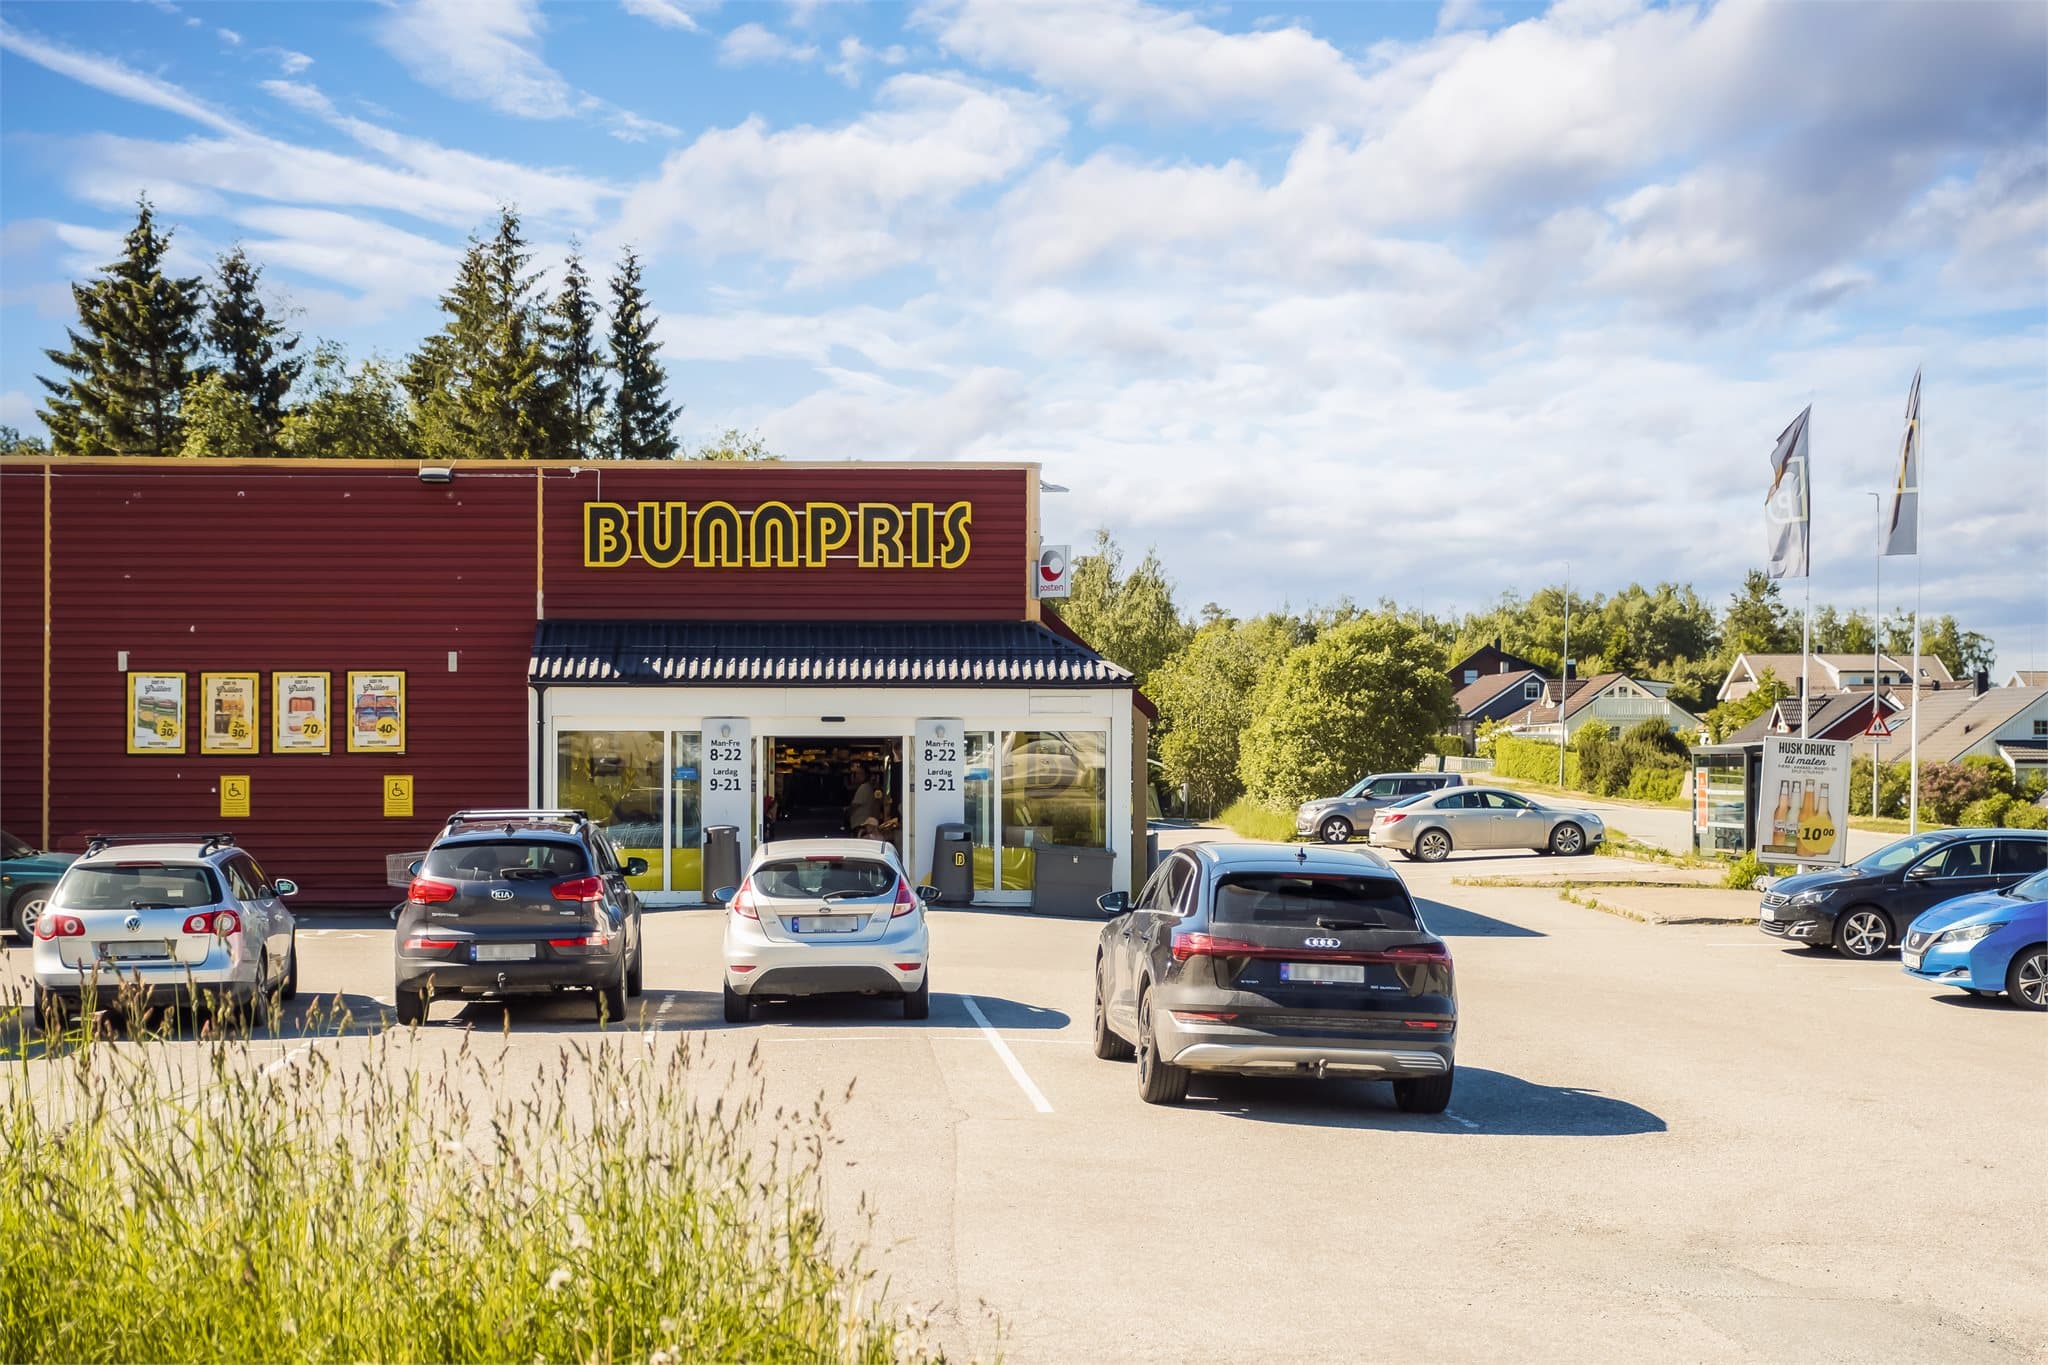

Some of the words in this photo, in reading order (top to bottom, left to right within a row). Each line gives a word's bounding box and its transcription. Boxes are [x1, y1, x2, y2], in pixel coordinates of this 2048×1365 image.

[583, 501, 972, 568] BUNNPRIS
[1040, 584, 1064, 592] posten
[710, 748, 742, 761] 8-22
[924, 749, 956, 761] 8-22
[1778, 741, 1803, 755] HUSK
[1804, 743, 1836, 757] DRIKKE
[713, 768, 738, 777] Lørdag
[927, 768, 953, 777] Lørdag
[710, 778, 742, 791] 9-21
[924, 778, 956, 791] 9-21
